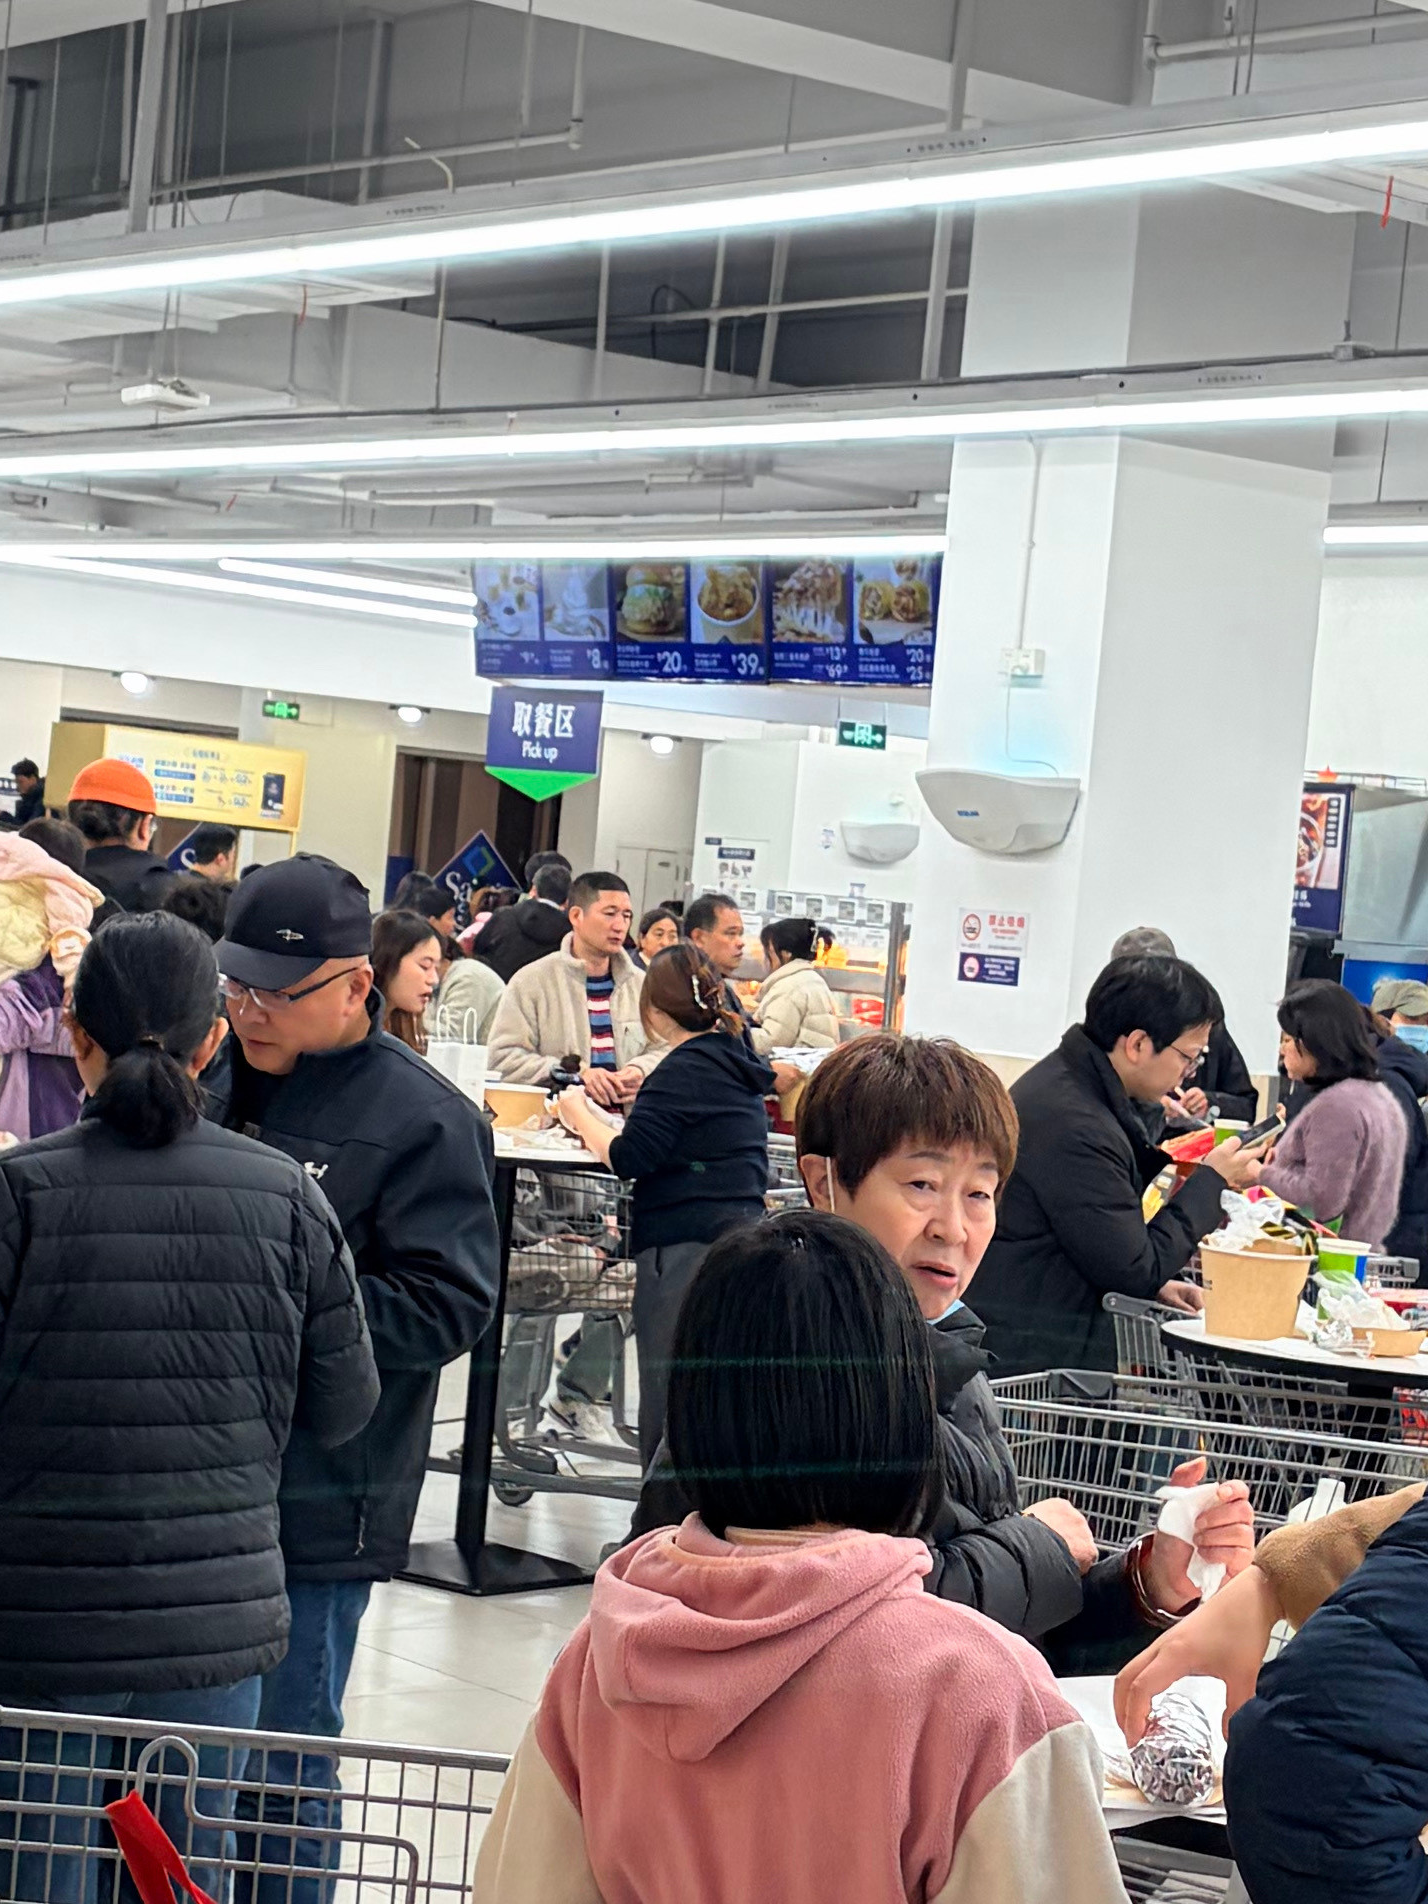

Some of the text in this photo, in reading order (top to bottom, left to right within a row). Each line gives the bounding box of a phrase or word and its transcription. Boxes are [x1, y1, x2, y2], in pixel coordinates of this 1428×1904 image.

[512, 701, 576, 738] 取餐区
[522, 740, 558, 764] Pick up
